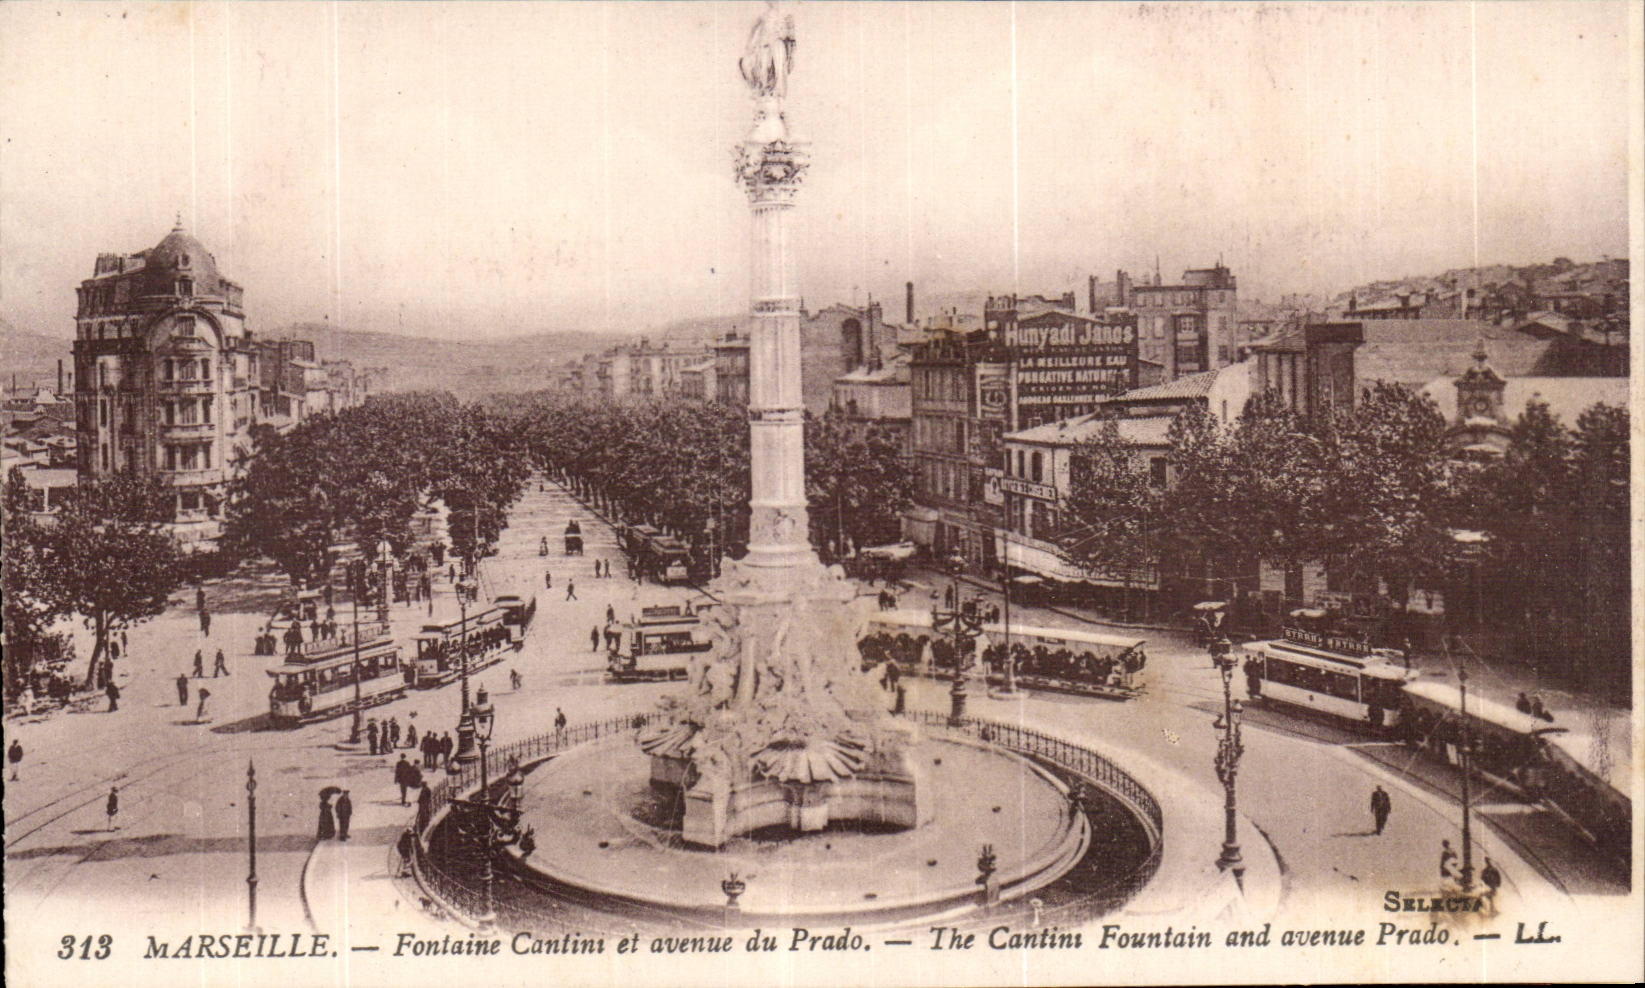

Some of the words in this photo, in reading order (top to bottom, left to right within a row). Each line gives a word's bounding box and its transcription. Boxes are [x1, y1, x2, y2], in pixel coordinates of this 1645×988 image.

[1005, 321, 1076, 350] Hunyadi
[1020, 357, 1033, 368] LA
[1037, 356, 1102, 367] MEILLEURE
[1106, 355, 1127, 365] EAU
